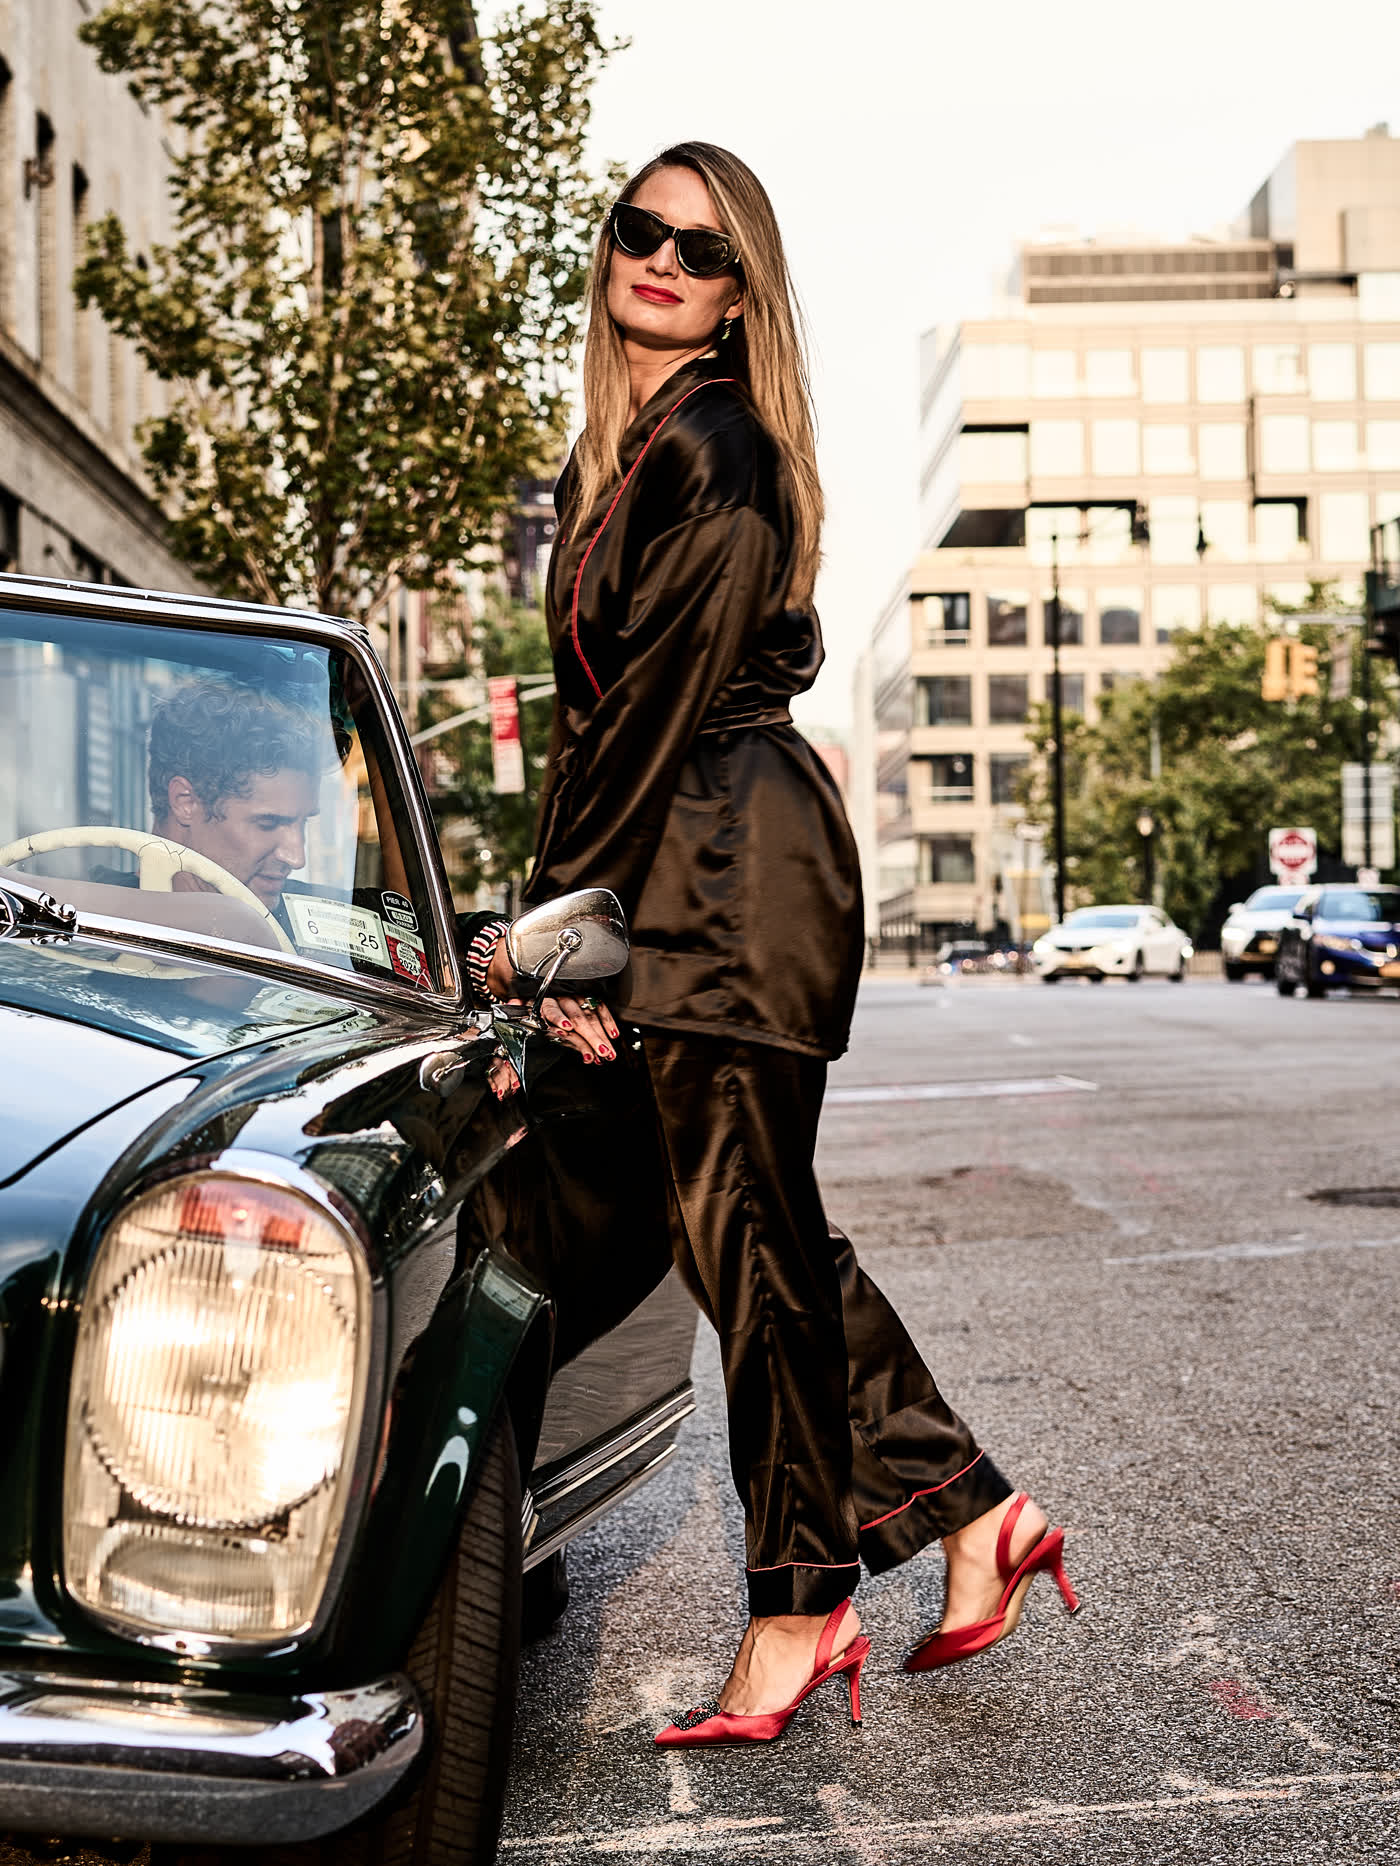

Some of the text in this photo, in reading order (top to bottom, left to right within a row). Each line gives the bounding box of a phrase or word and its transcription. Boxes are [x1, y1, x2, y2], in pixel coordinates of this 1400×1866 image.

[386, 896, 400, 905] PIER
[308, 920, 379, 950] 6 25
